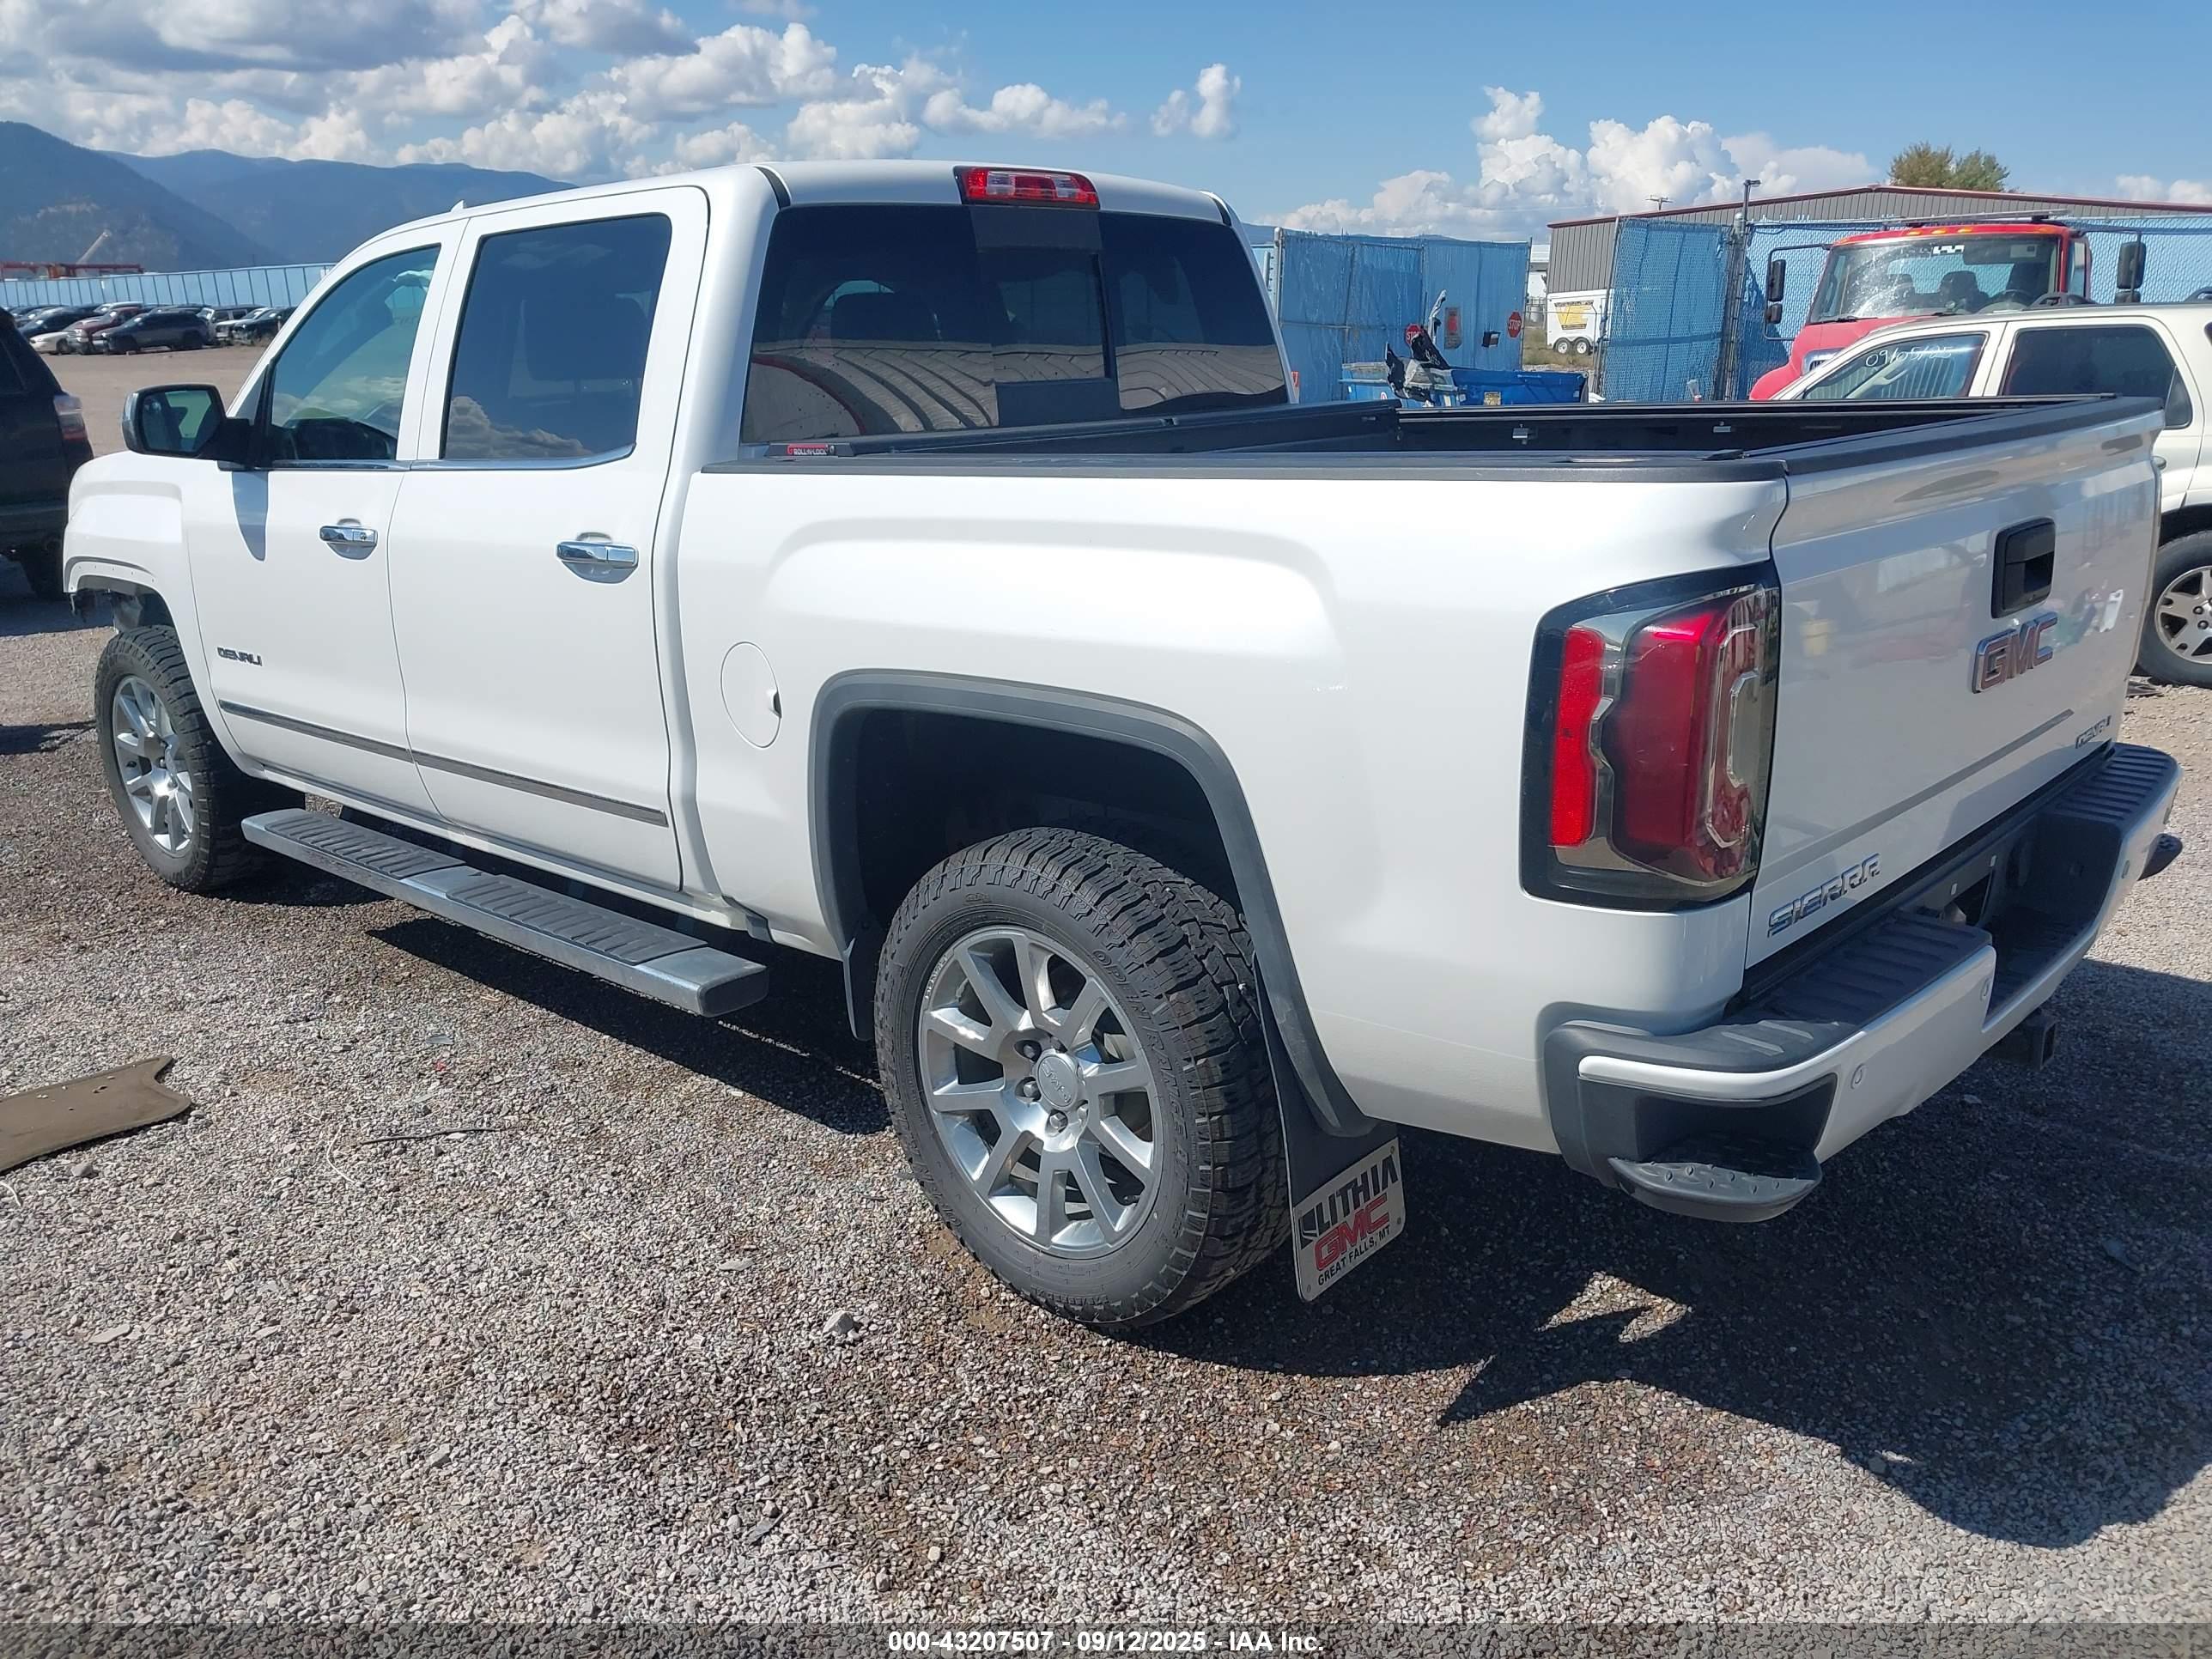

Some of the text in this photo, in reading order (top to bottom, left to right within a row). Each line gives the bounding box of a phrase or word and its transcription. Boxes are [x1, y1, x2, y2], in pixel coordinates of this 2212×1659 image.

[1509, 319, 1522, 331] STOP
[1865, 345, 1953, 367] 09/05/25
[216, 647, 263, 667] DENALI
[1972, 611, 2058, 694] GMC
[1767, 853, 1881, 938] SIERRA
[1316, 1154, 1399, 1237] LITHIA
[1314, 1192, 1390, 1272] GMC
[1318, 1224, 1391, 1285] GREAT FALLS, MT
